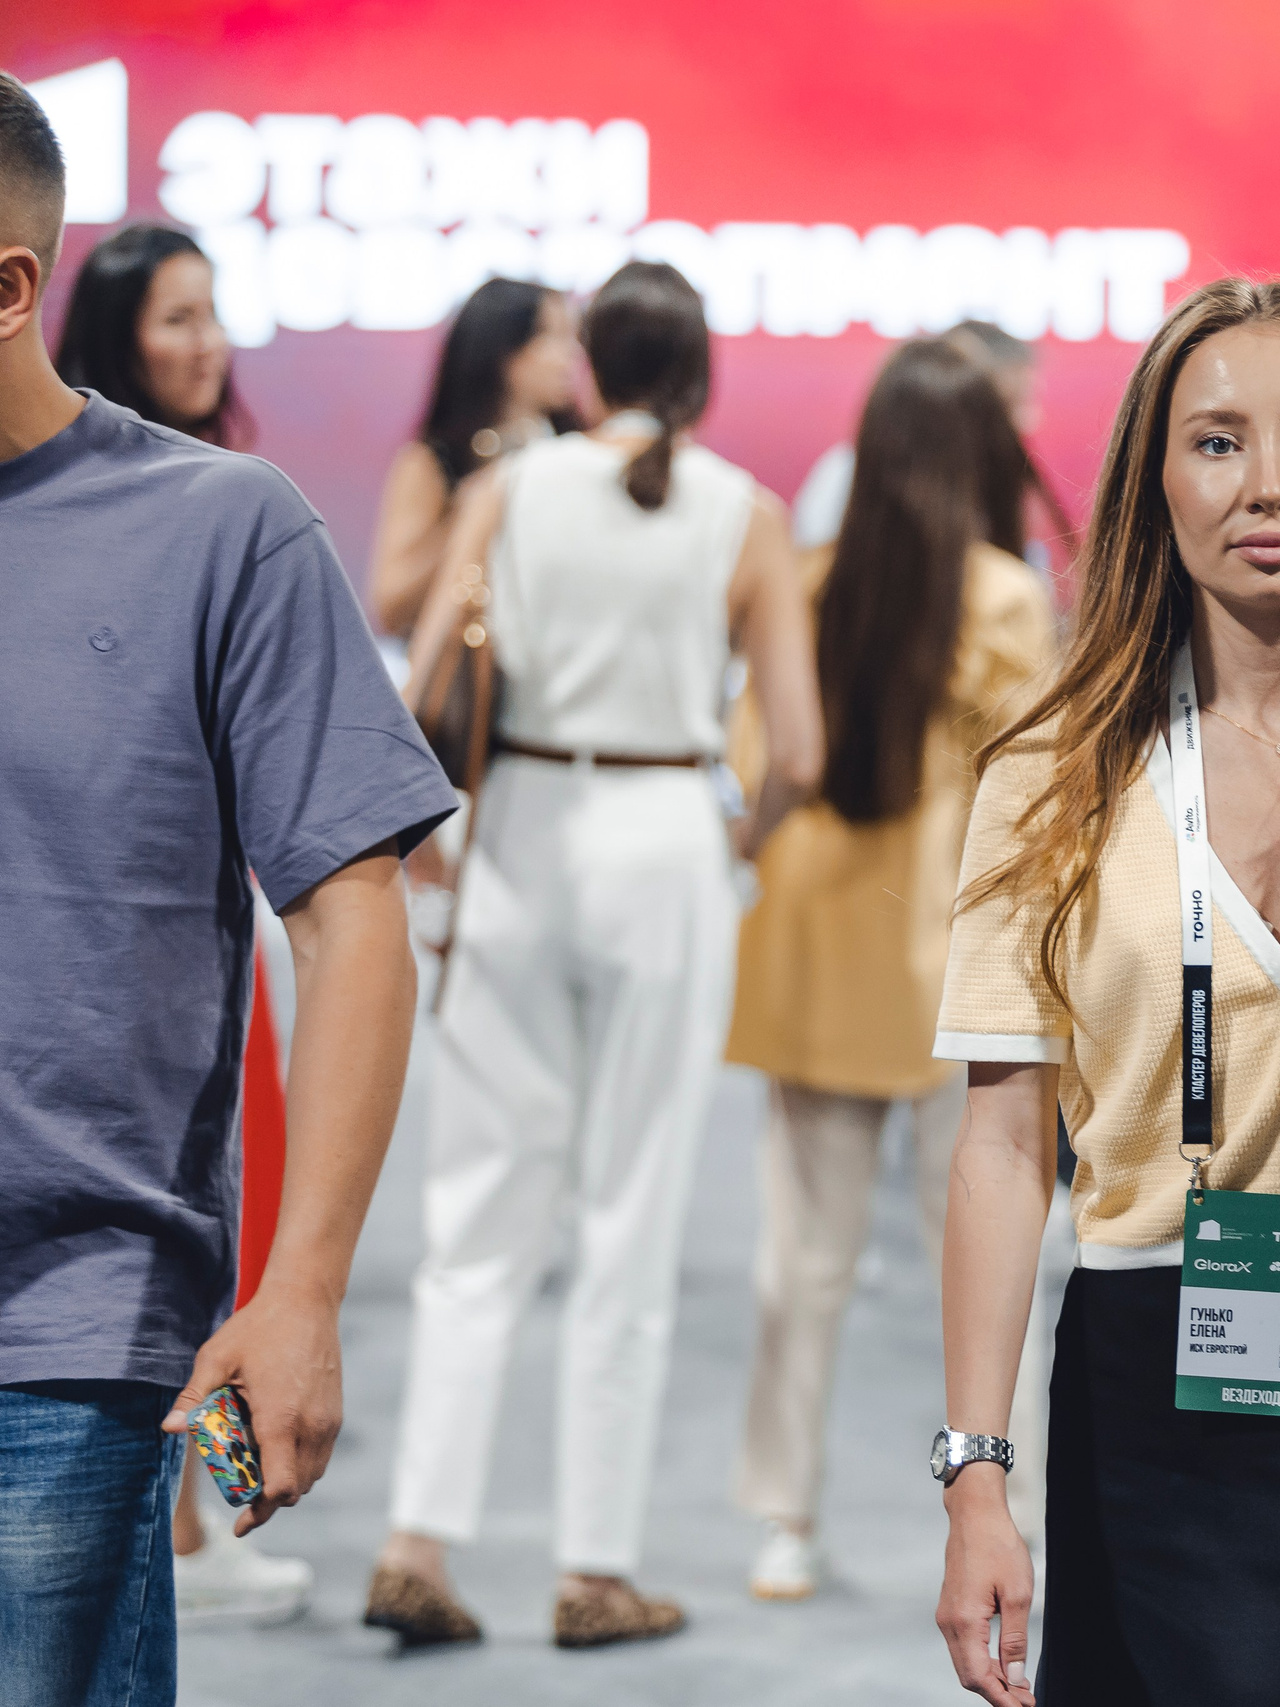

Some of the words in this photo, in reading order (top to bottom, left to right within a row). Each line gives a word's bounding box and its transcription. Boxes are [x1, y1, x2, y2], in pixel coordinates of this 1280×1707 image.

[1193, 889, 1204, 942] ТОЧНО
[1192, 989, 1206, 1057] ДЕВЕЛОПЕРОВ
[1192, 1057, 1205, 1100] КЛАСТЕР
[1194, 1258, 1253, 1273] GloraX
[1190, 1307, 1233, 1322] ГУНЬКО
[1190, 1323, 1226, 1338] ЕЛЕНА
